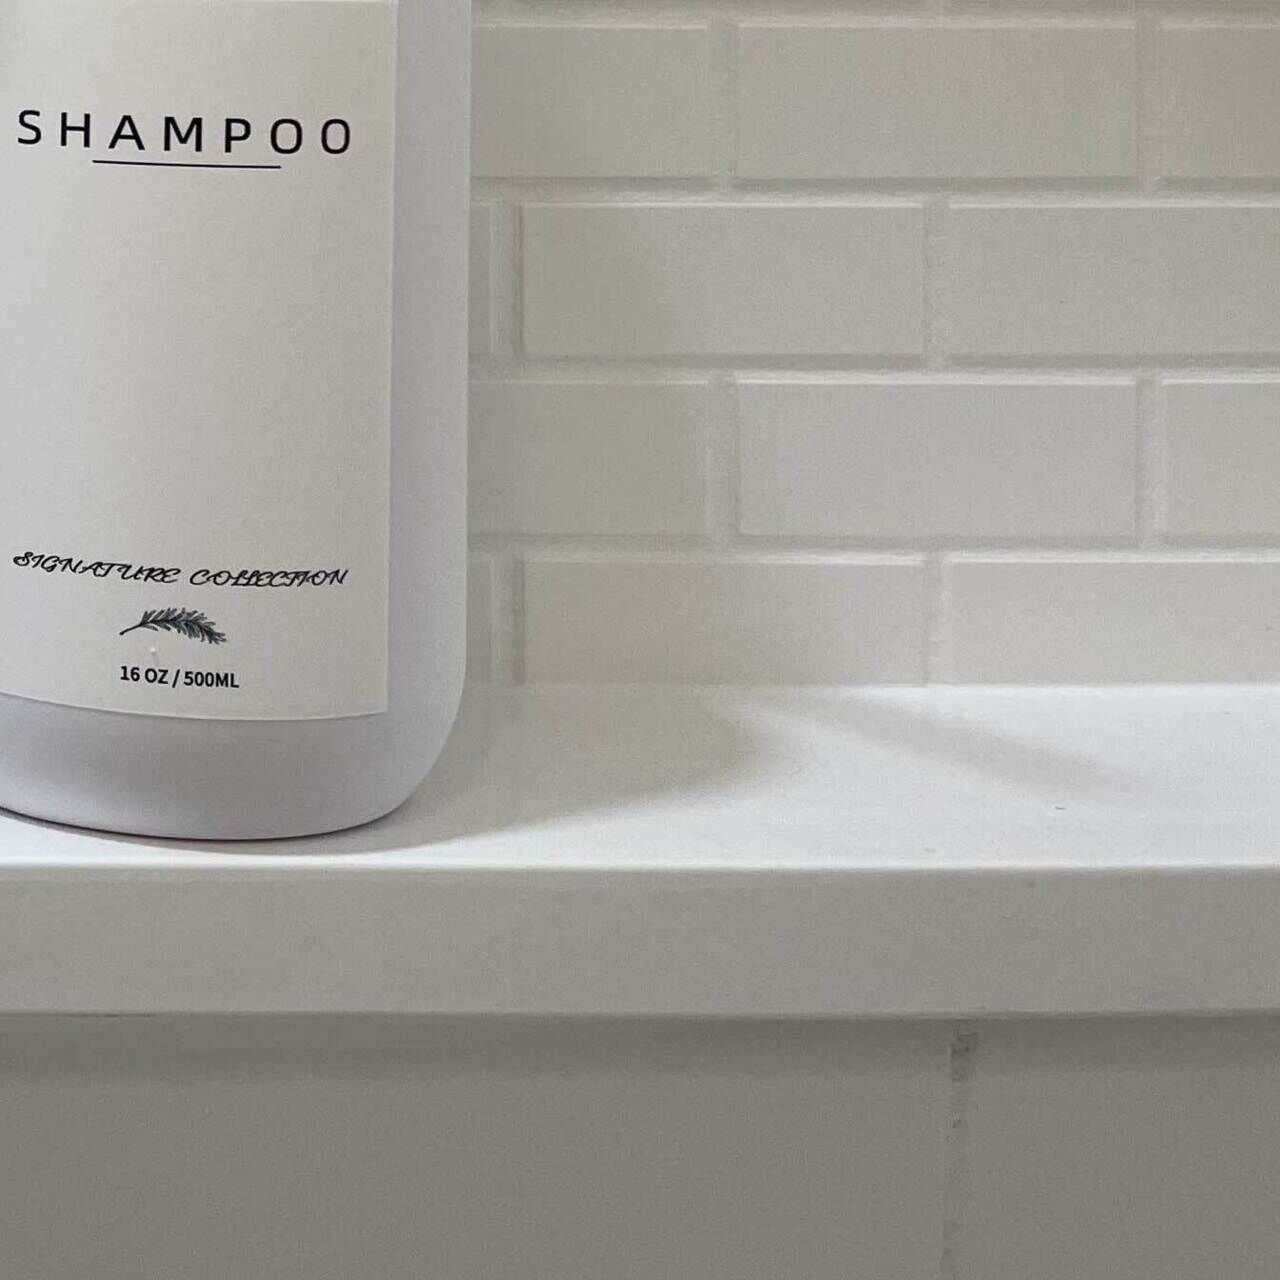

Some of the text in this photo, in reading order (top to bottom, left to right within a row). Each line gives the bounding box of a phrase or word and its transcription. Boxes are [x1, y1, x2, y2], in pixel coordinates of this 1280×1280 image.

[17, 109, 351, 155] SHAMPOO
[12, 550, 350, 588] SIGNATURE COLLECTION
[119, 665, 141, 683] 16
[144, 667, 169, 685] OZ
[183, 670, 240, 689] 500ML
